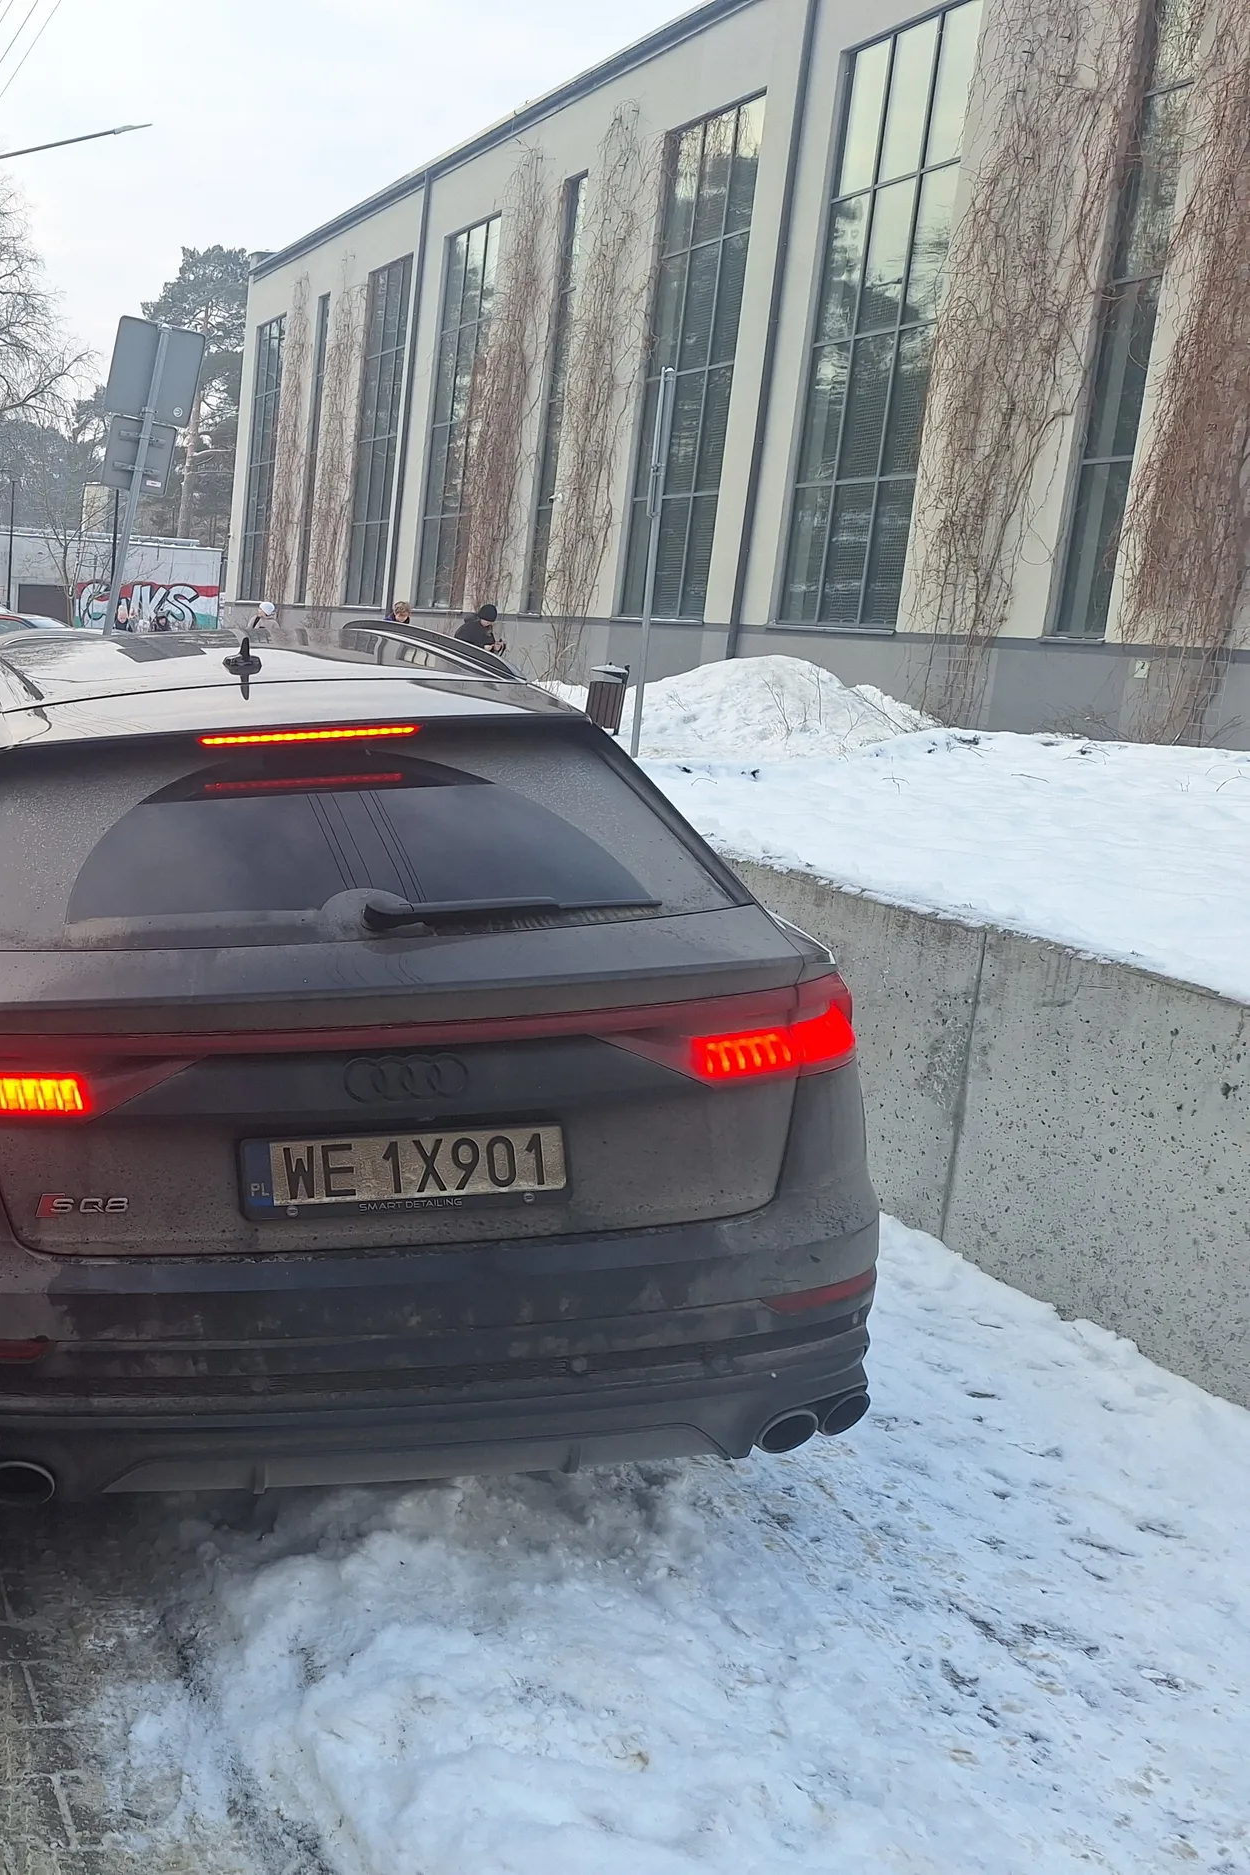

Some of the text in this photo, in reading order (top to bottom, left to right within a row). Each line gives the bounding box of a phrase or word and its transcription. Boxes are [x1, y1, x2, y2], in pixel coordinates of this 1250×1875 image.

[283, 1133, 545, 1199] WE 1X901
[250, 1182, 270, 1197] PL
[50, 1197, 129, 1213] SQ8
[358, 1198, 463, 1212] SMART DETAILING
